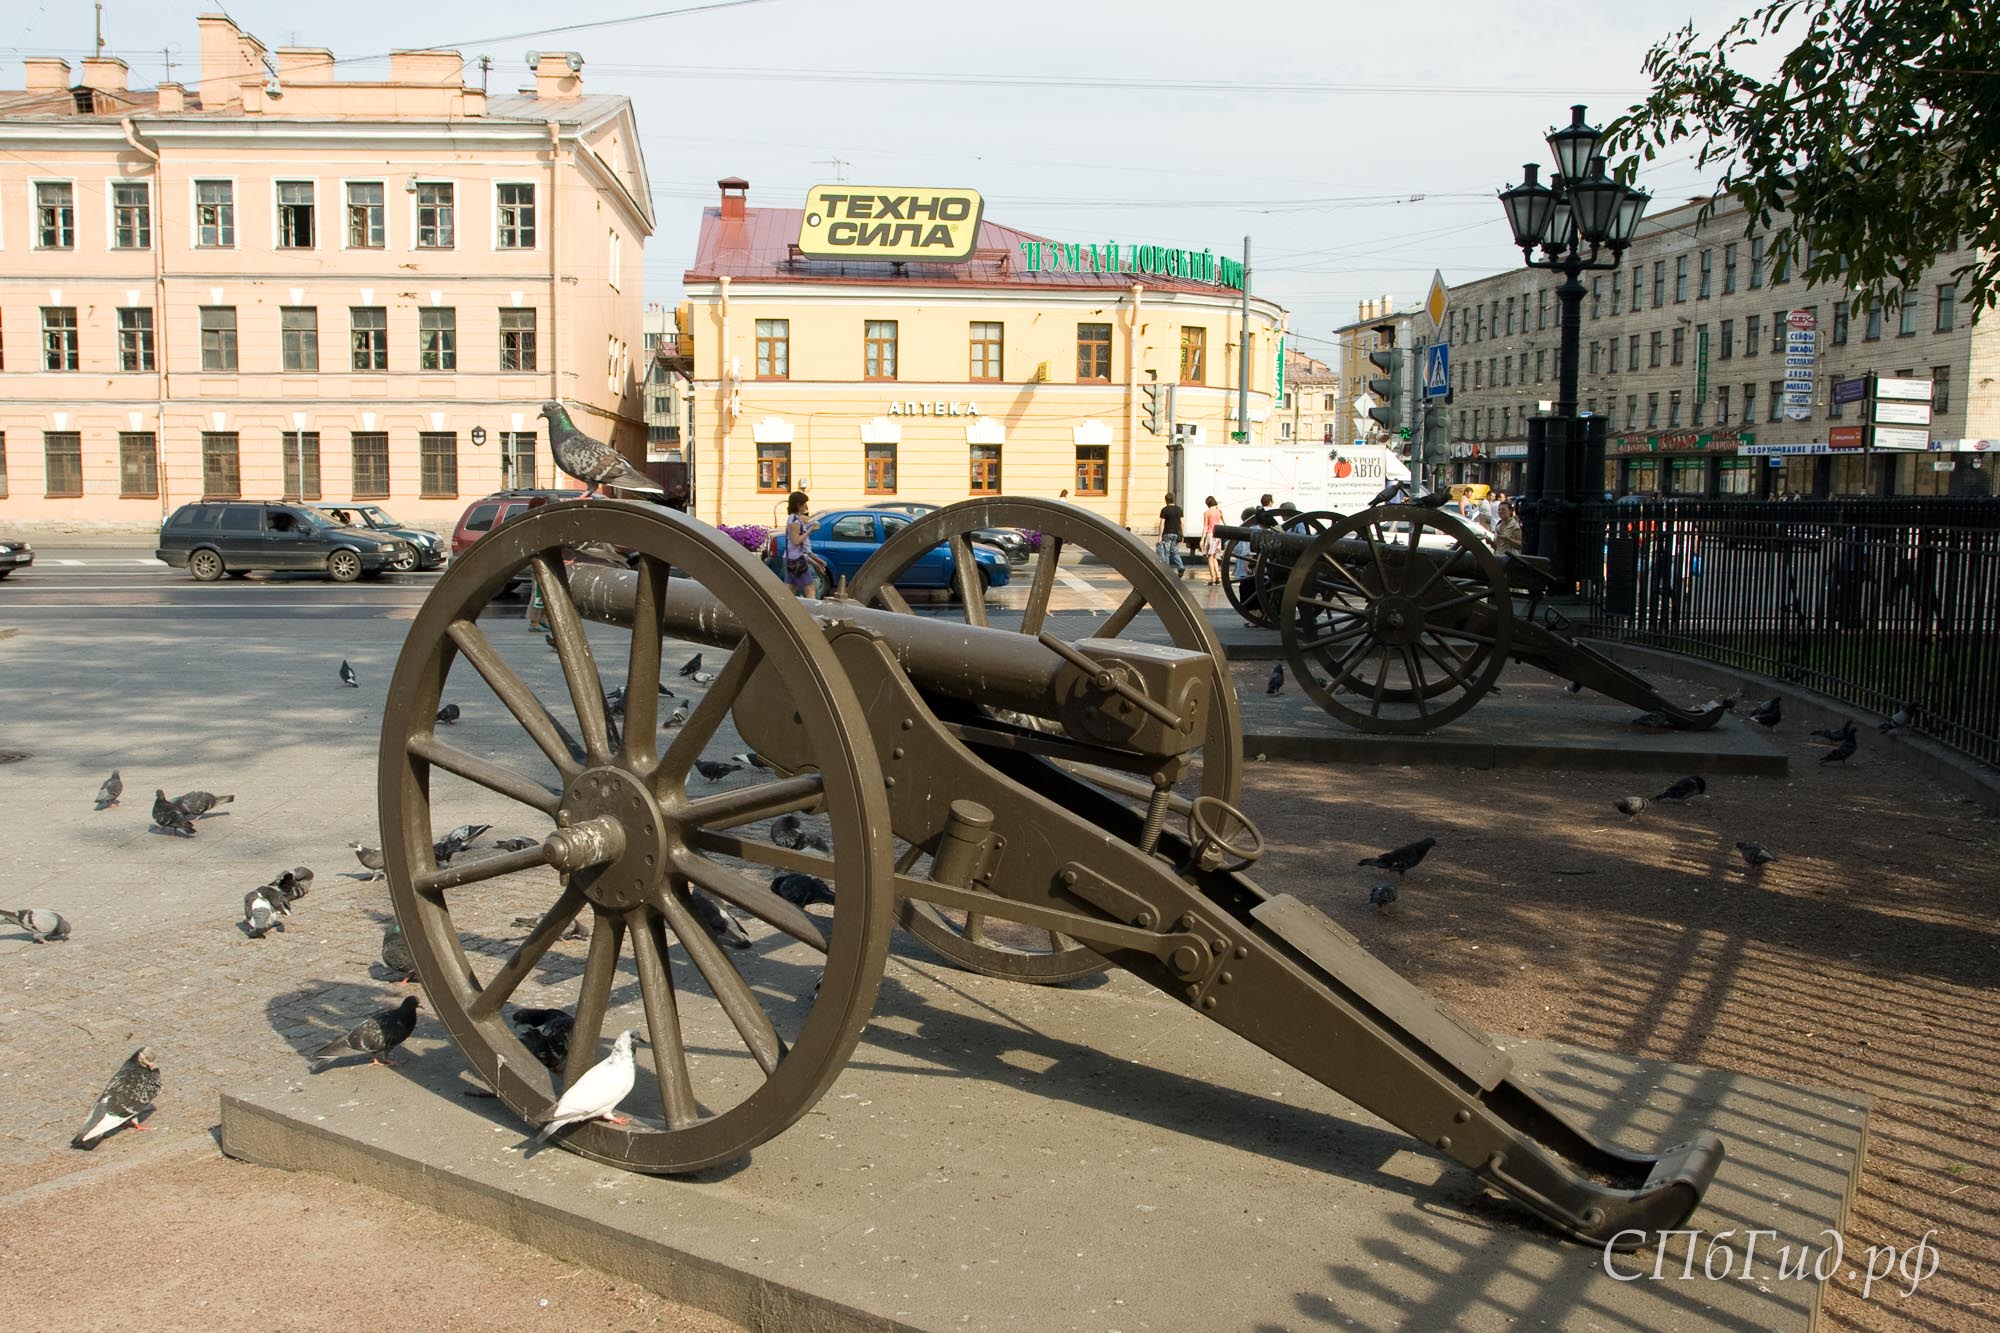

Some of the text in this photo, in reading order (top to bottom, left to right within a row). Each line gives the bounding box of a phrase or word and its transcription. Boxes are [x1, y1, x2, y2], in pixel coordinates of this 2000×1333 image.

[820, 194, 971, 222] ТЕХНО
[828, 221, 955, 249] СИЛА
[1019, 239, 1215, 282] ИЗМАЙЛОВСКИЙ
[1790, 332, 1814, 341] СЕЙФЫ
[1789, 345, 1814, 353] ШКАФЫ
[1785, 383, 1812, 391] МЕБЕЛЬ
[887, 400, 980, 417] АПТЕКА
[1747, 445, 1806, 454] ОБОРУВАНИЕ
[1353, 464, 1382, 478] АВТО
